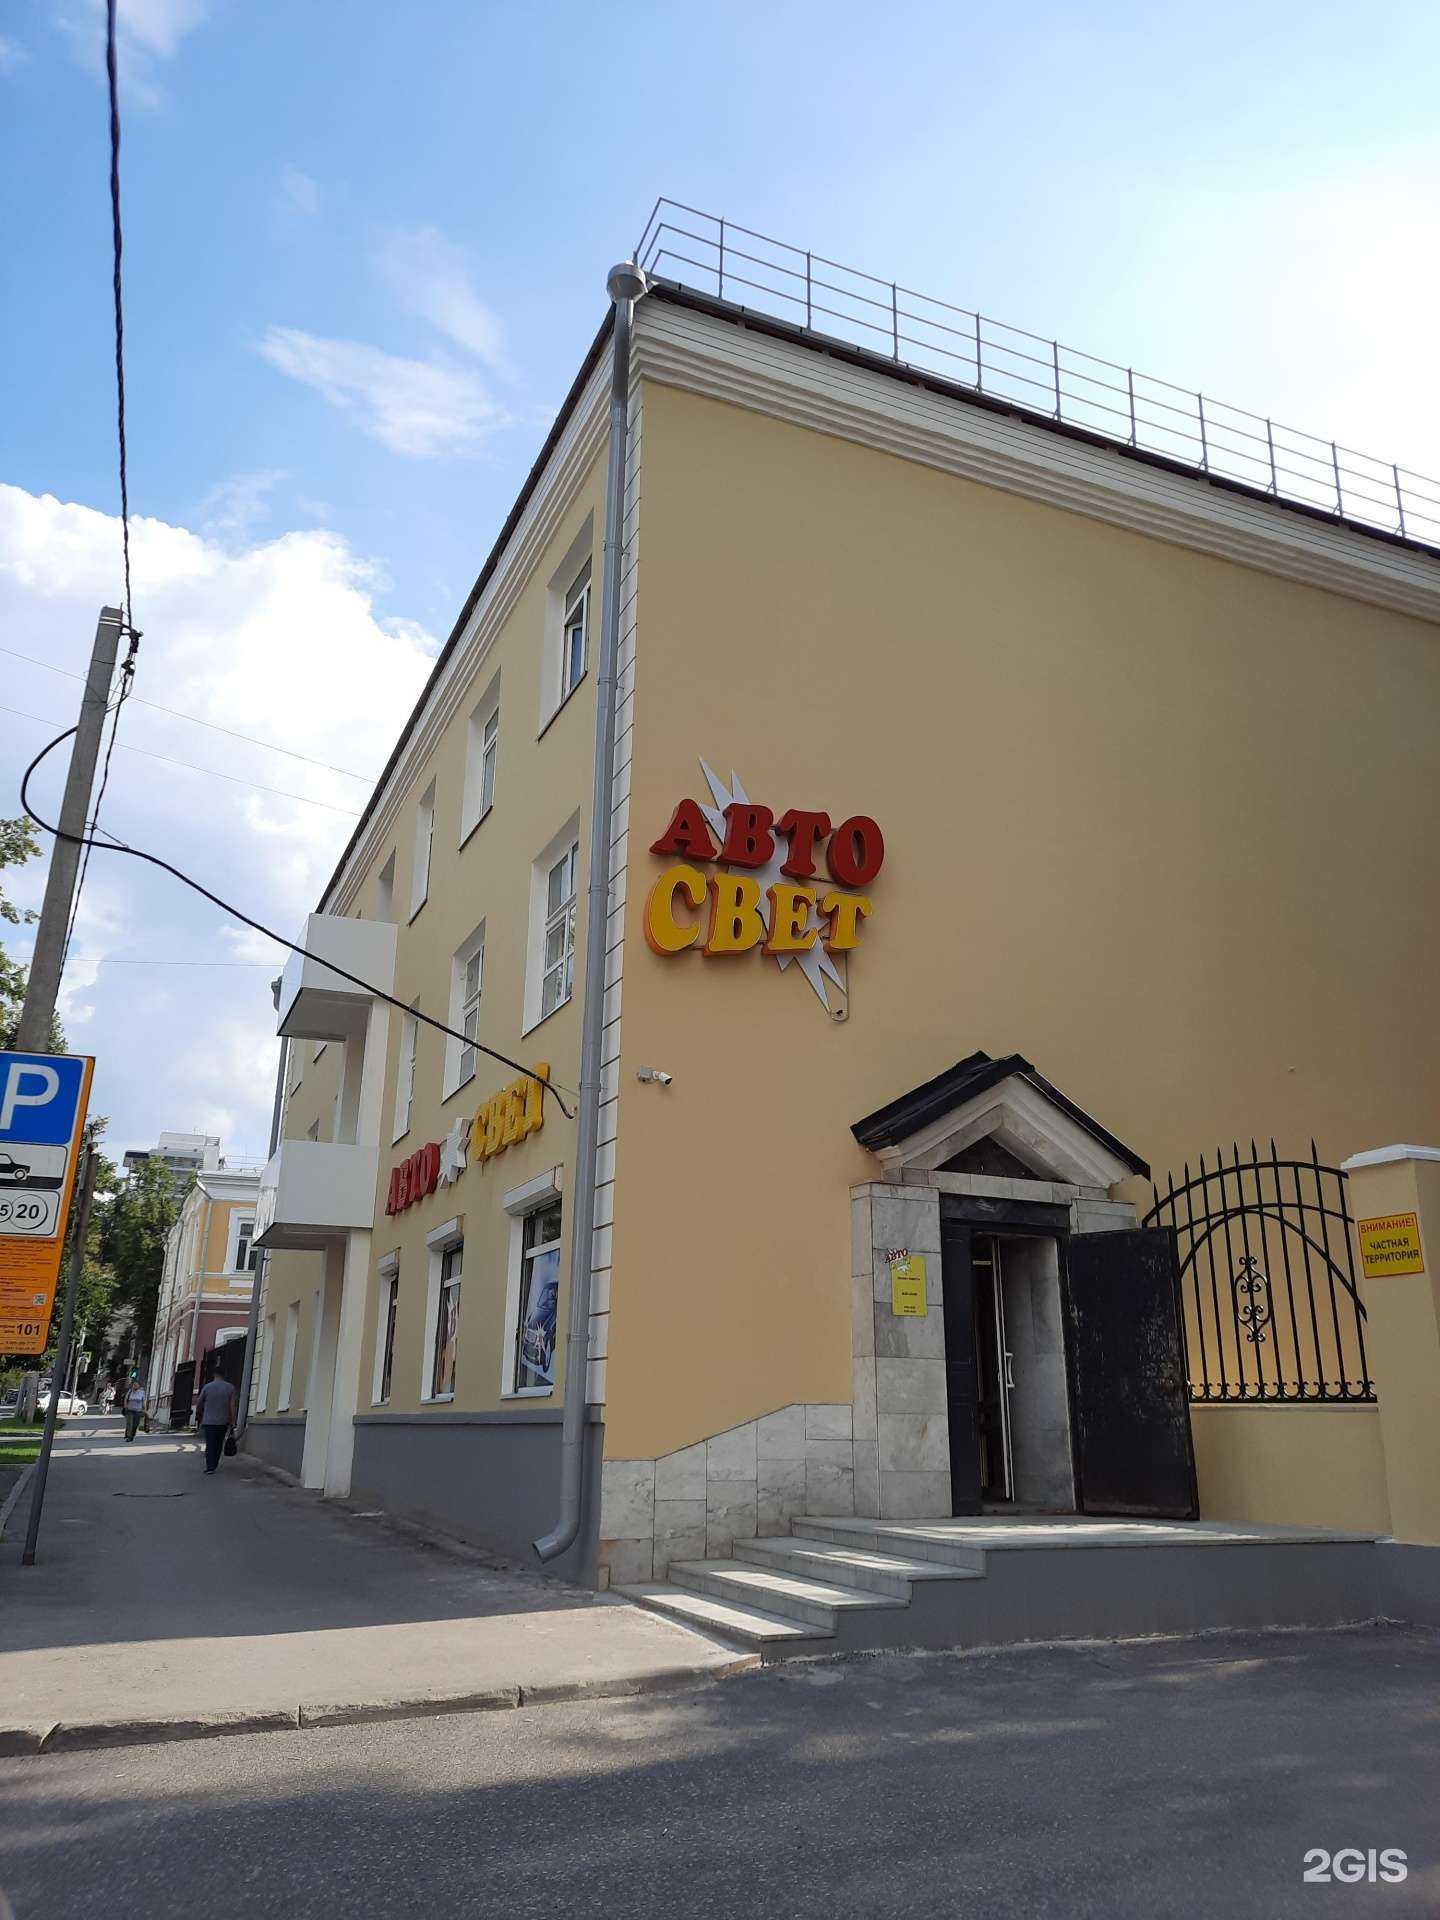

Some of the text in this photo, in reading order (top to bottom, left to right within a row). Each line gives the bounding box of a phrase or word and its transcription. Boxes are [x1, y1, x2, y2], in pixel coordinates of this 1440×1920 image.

[648, 798, 885, 887] АВТО
[643, 864, 872, 955] СВЕТ
[0, 1062, 60, 1130] P
[16, 1204, 39, 1219] 20
[1360, 1217, 1415, 1233] ВНИМАНИЕ!
[1370, 1237, 1409, 1250] ЧАСТНАЯ
[1365, 1249, 1419, 1264] ТЕРРИТОРИЯ
[16, 1323, 41, 1336] 101
